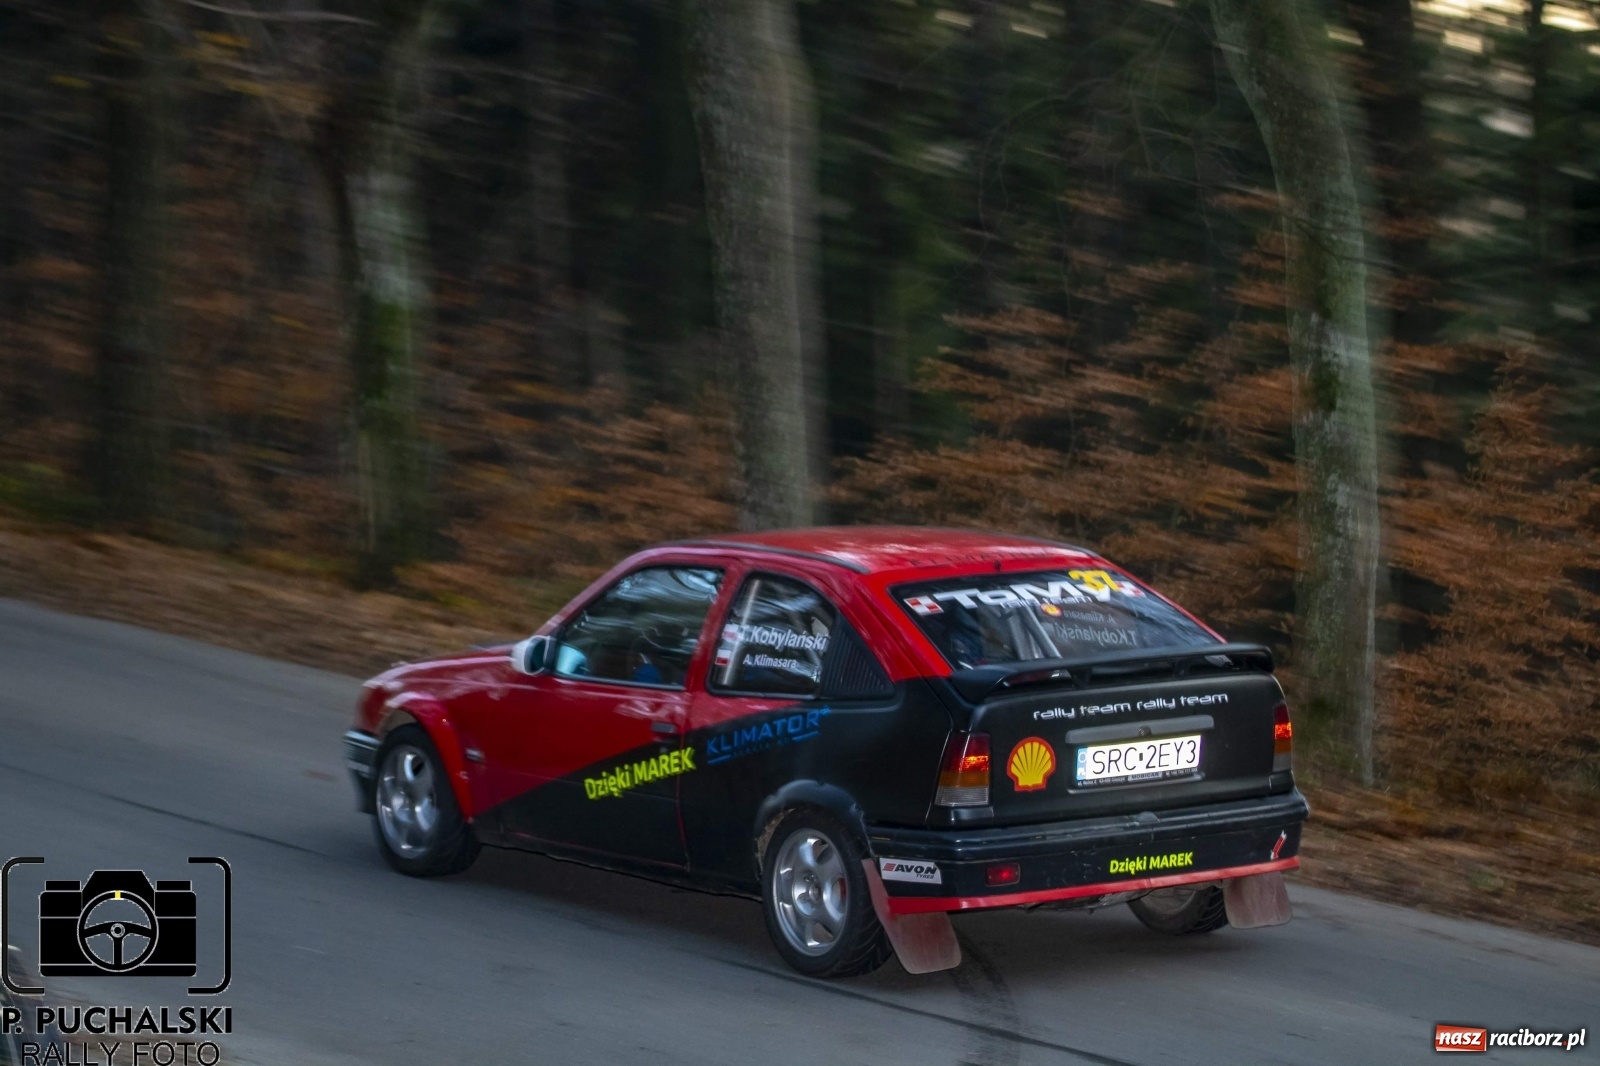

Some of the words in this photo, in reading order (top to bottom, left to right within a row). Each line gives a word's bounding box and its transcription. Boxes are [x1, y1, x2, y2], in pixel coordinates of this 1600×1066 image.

[1069, 569, 1122, 593] 37
[754, 654, 797, 668] Klimasara
[1033, 704, 1075, 721] rally
[1079, 701, 1131, 716] team
[1136, 697, 1176, 712] rally
[1180, 693, 1229, 707] team
[706, 709, 819, 756] KLIMATOR
[1092, 747, 1137, 775] SRC
[1145, 740, 1197, 769] 2EY3
[583, 764, 632, 800] Dzięki
[633, 747, 697, 784] MAREK
[894, 864, 938, 875] AVON
[1109, 856, 1148, 876] Dzięki
[1148, 851, 1194, 870] MAREK
